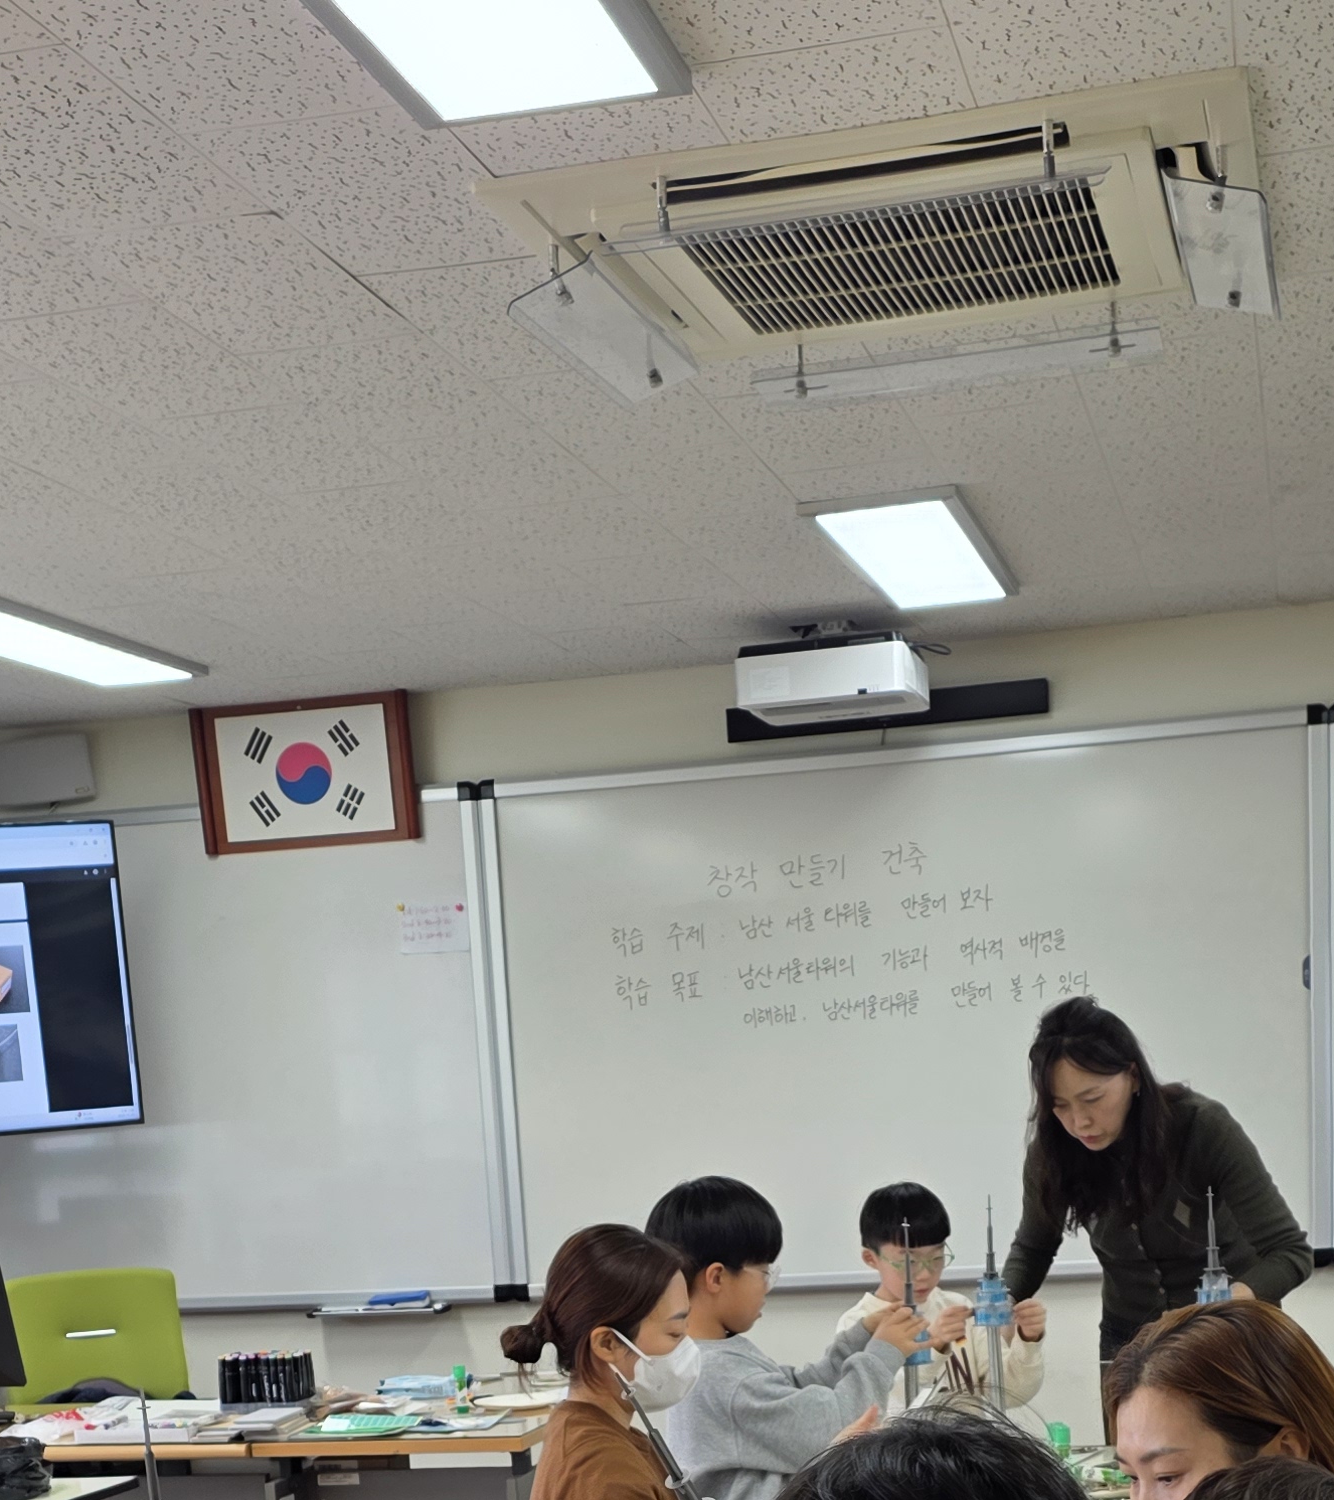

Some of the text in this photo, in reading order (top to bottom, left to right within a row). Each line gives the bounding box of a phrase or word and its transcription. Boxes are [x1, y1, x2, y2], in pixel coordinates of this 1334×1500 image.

[706, 841, 927, 898] 창작 만들기 건축
[611, 927, 644, 958] 학습
[666, 922, 706, 952] 주제
[738, 914, 774, 941] 남산
[785, 906, 816, 933] 서울
[823, 900, 873, 930] 타워를
[900, 891, 947, 920] 만들어
[959, 883, 994, 912] 보자
[614, 974, 652, 1011] 학습
[671, 970, 703, 1003] 목표
[881, 944, 929, 972] 기능과
[959, 936, 1003, 966] 역사적
[1018, 928, 1066, 959] 배경을
[950, 980, 992, 1009] 만들어
[1009, 973, 1024, 1003] 볼
[1031, 973, 1047, 1000] 수
[1058, 969, 1091, 996] 있다
